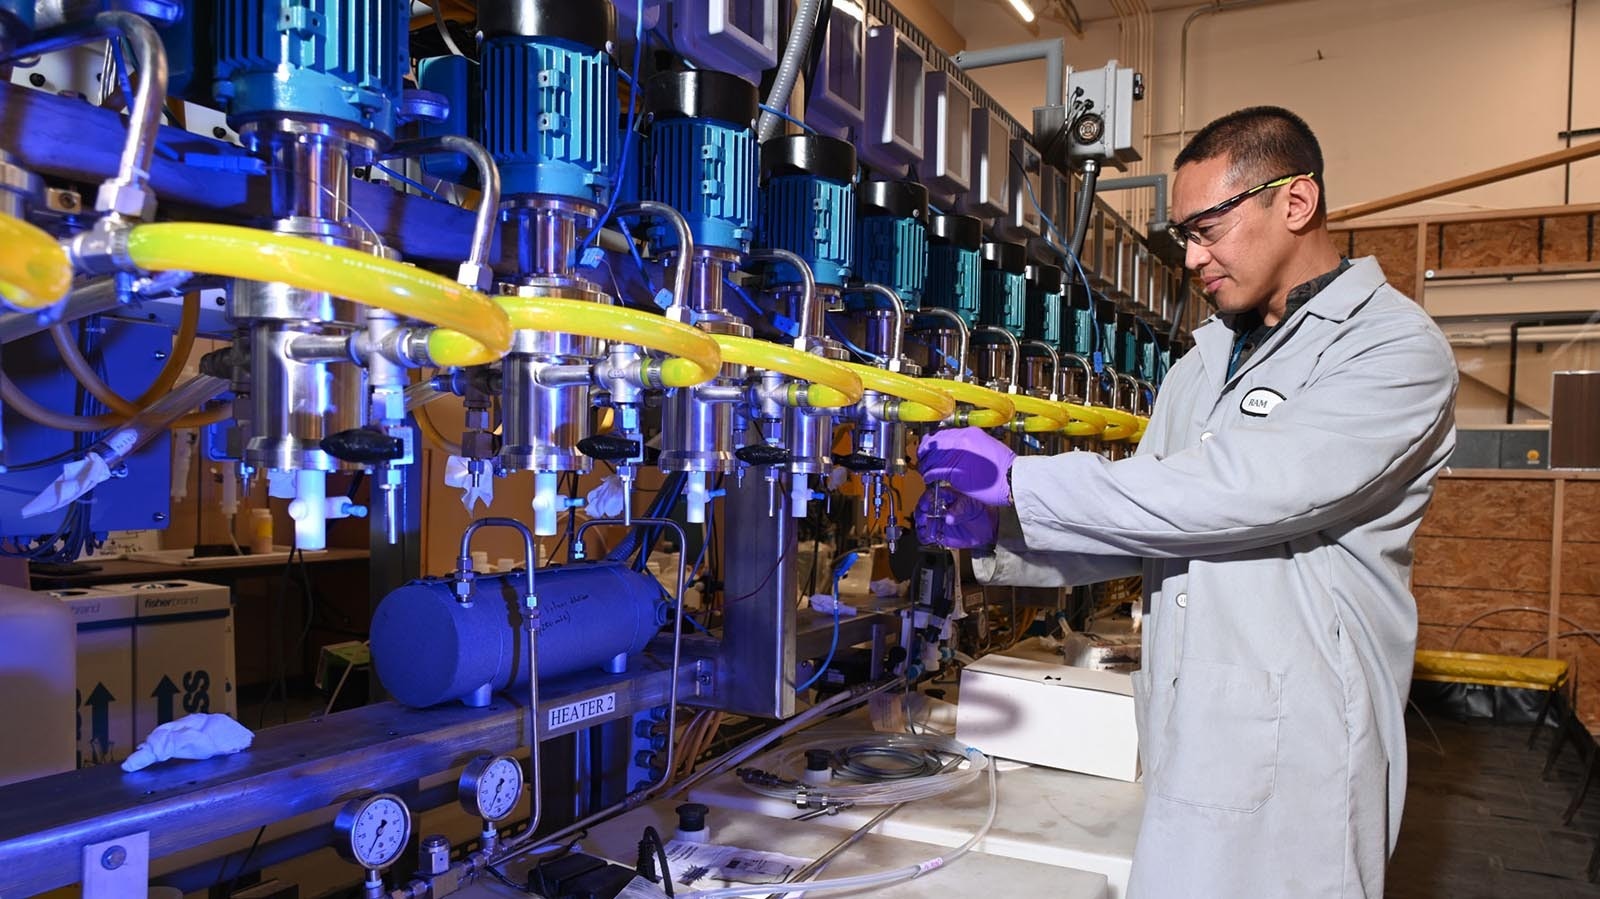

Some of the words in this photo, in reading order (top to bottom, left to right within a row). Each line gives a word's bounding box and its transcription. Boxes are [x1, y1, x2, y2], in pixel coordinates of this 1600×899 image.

[1248, 398, 1268, 408] RAM
[551, 699, 604, 726] HEATER
[607, 696, 614, 710] 2
